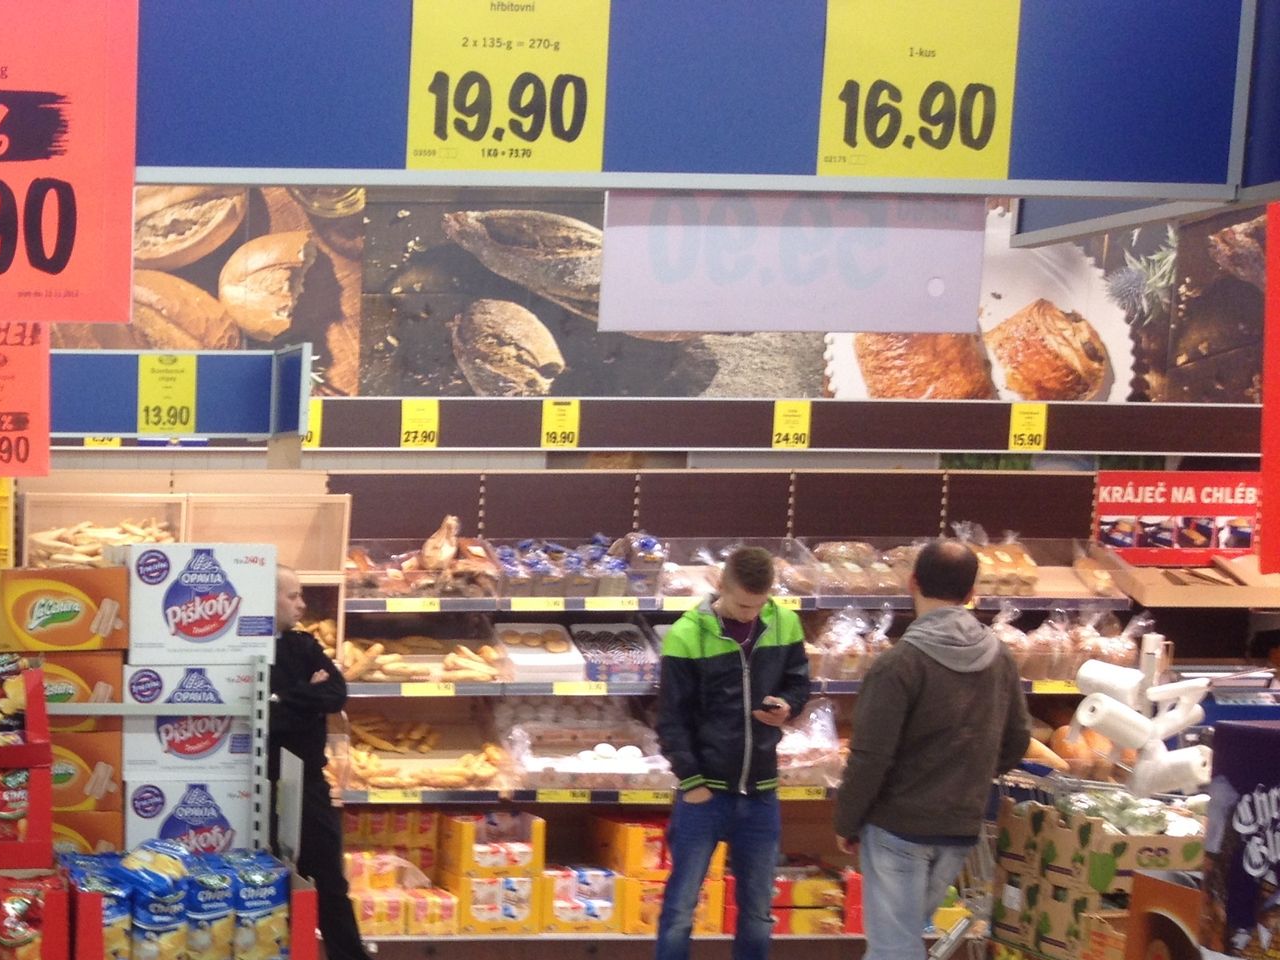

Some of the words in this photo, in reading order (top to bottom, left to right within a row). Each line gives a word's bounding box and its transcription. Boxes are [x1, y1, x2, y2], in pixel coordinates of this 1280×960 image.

[462, 37, 469, 47] 2
[427, 70, 588, 143] 19.90
[838, 79, 996, 151] 16.90
[143, 405, 190, 426] 13.90
[403, 431, 436, 443] 27.90
[775, 432, 807, 445] 24.90
[1098, 481, 1167, 503] KRÁJEČ
[1171, 487, 1197, 503] NA
[1201, 483, 1258, 504] CHLÉB
